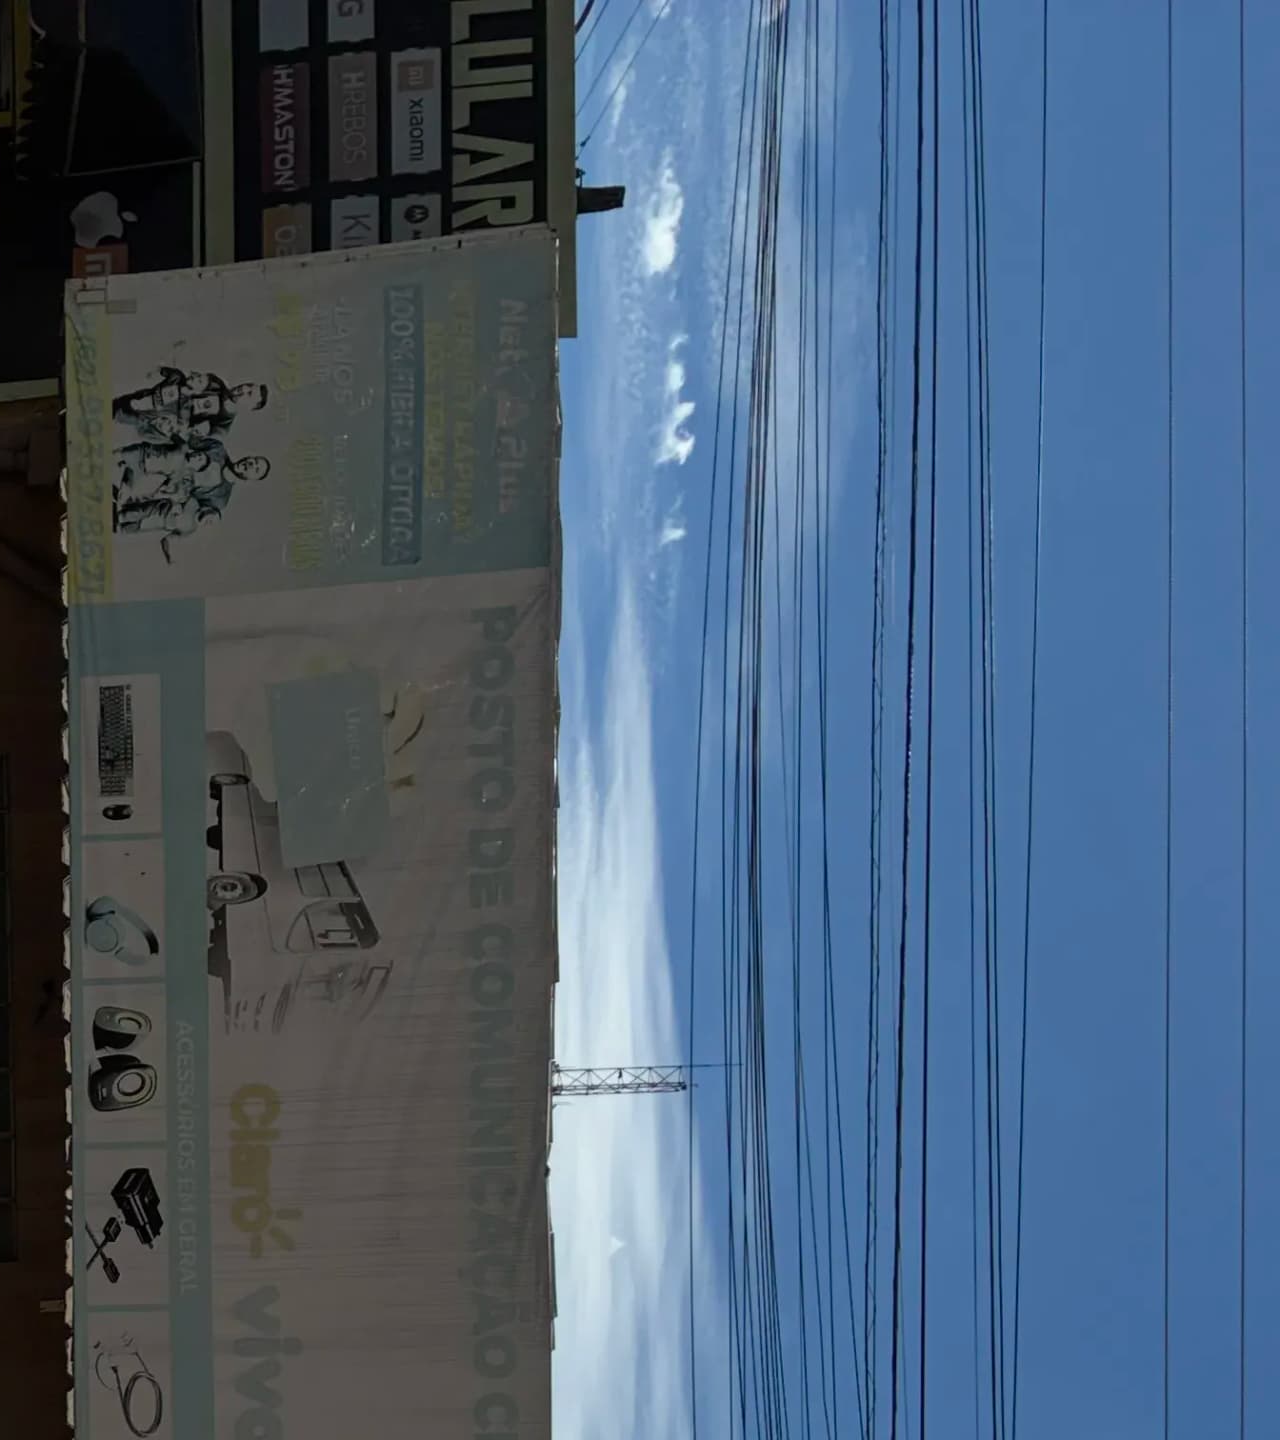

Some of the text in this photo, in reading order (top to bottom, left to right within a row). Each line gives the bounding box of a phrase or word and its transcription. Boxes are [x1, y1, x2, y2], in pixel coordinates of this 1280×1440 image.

[408, 98, 425, 162] xiaomi
[389, 288, 416, 361] 100%
[467, 604, 517, 814] POSTO
[469, 828, 516, 909] DE
[176, 1218, 198, 1297] GERAL
